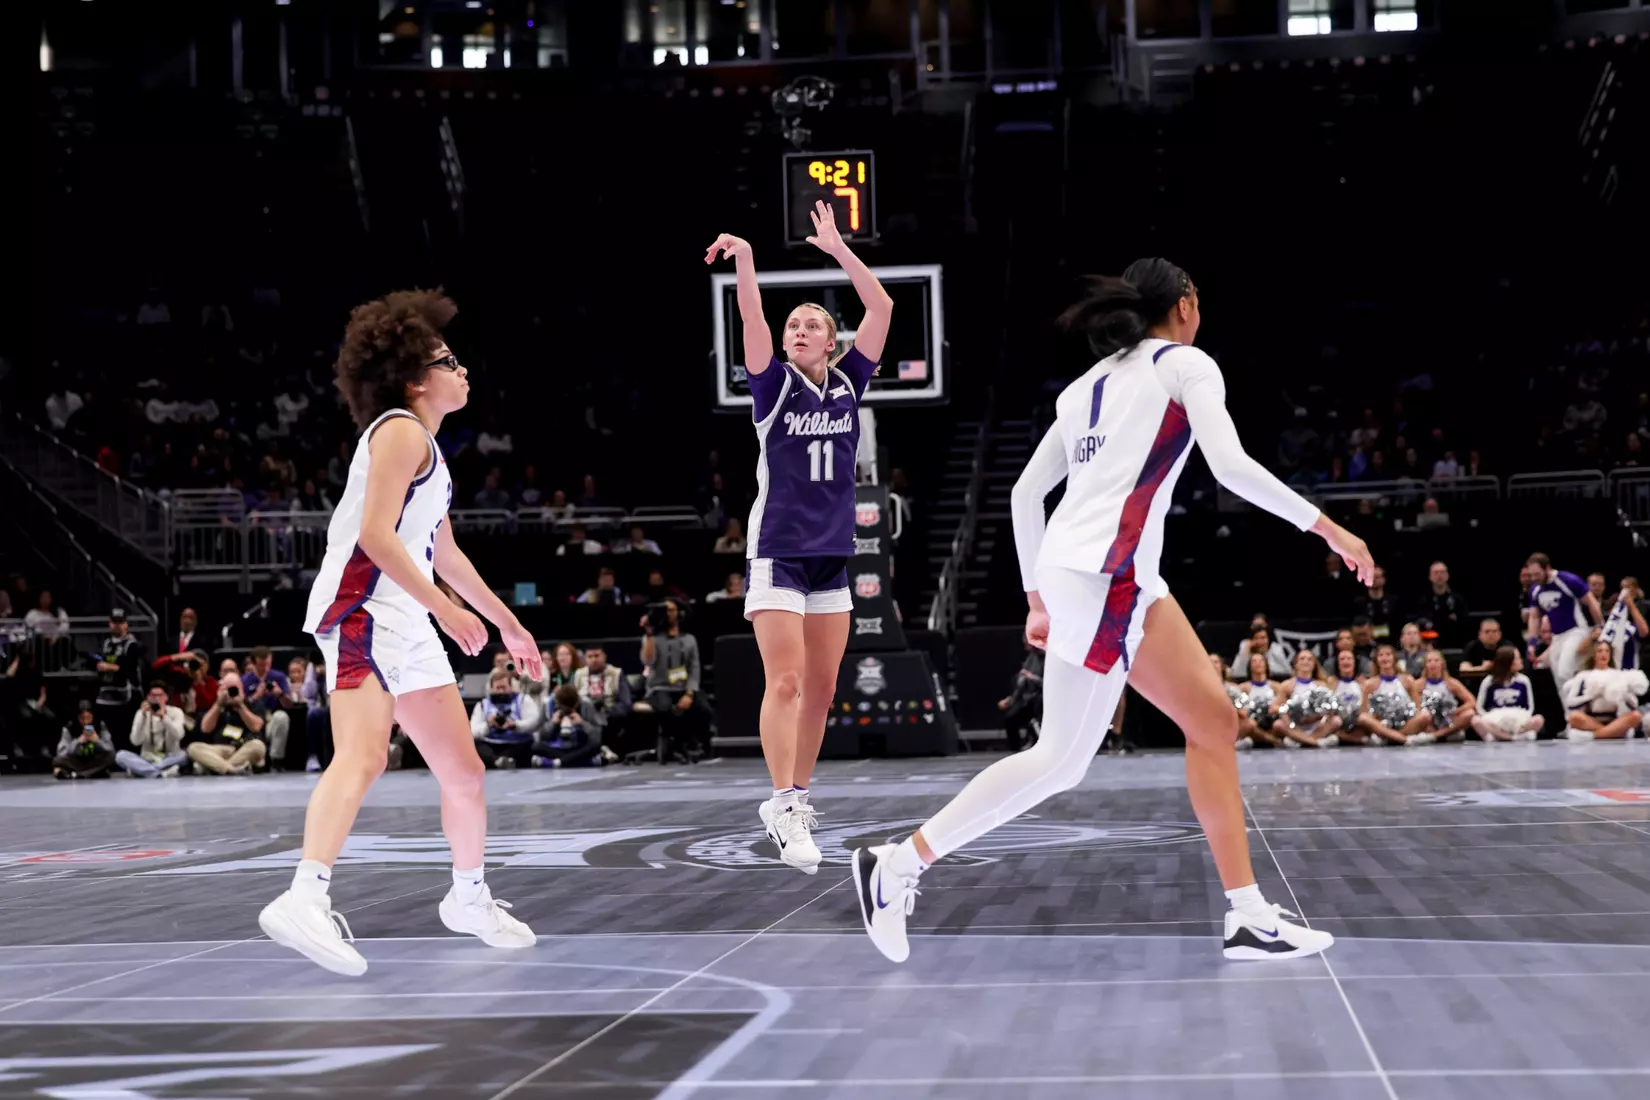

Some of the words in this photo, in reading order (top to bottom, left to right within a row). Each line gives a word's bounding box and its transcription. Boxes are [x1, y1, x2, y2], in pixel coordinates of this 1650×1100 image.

[809, 160, 865, 186] 9:21
[834, 187, 859, 231] 7
[784, 410, 852, 436] Wildcats
[807, 440, 834, 481] 11
